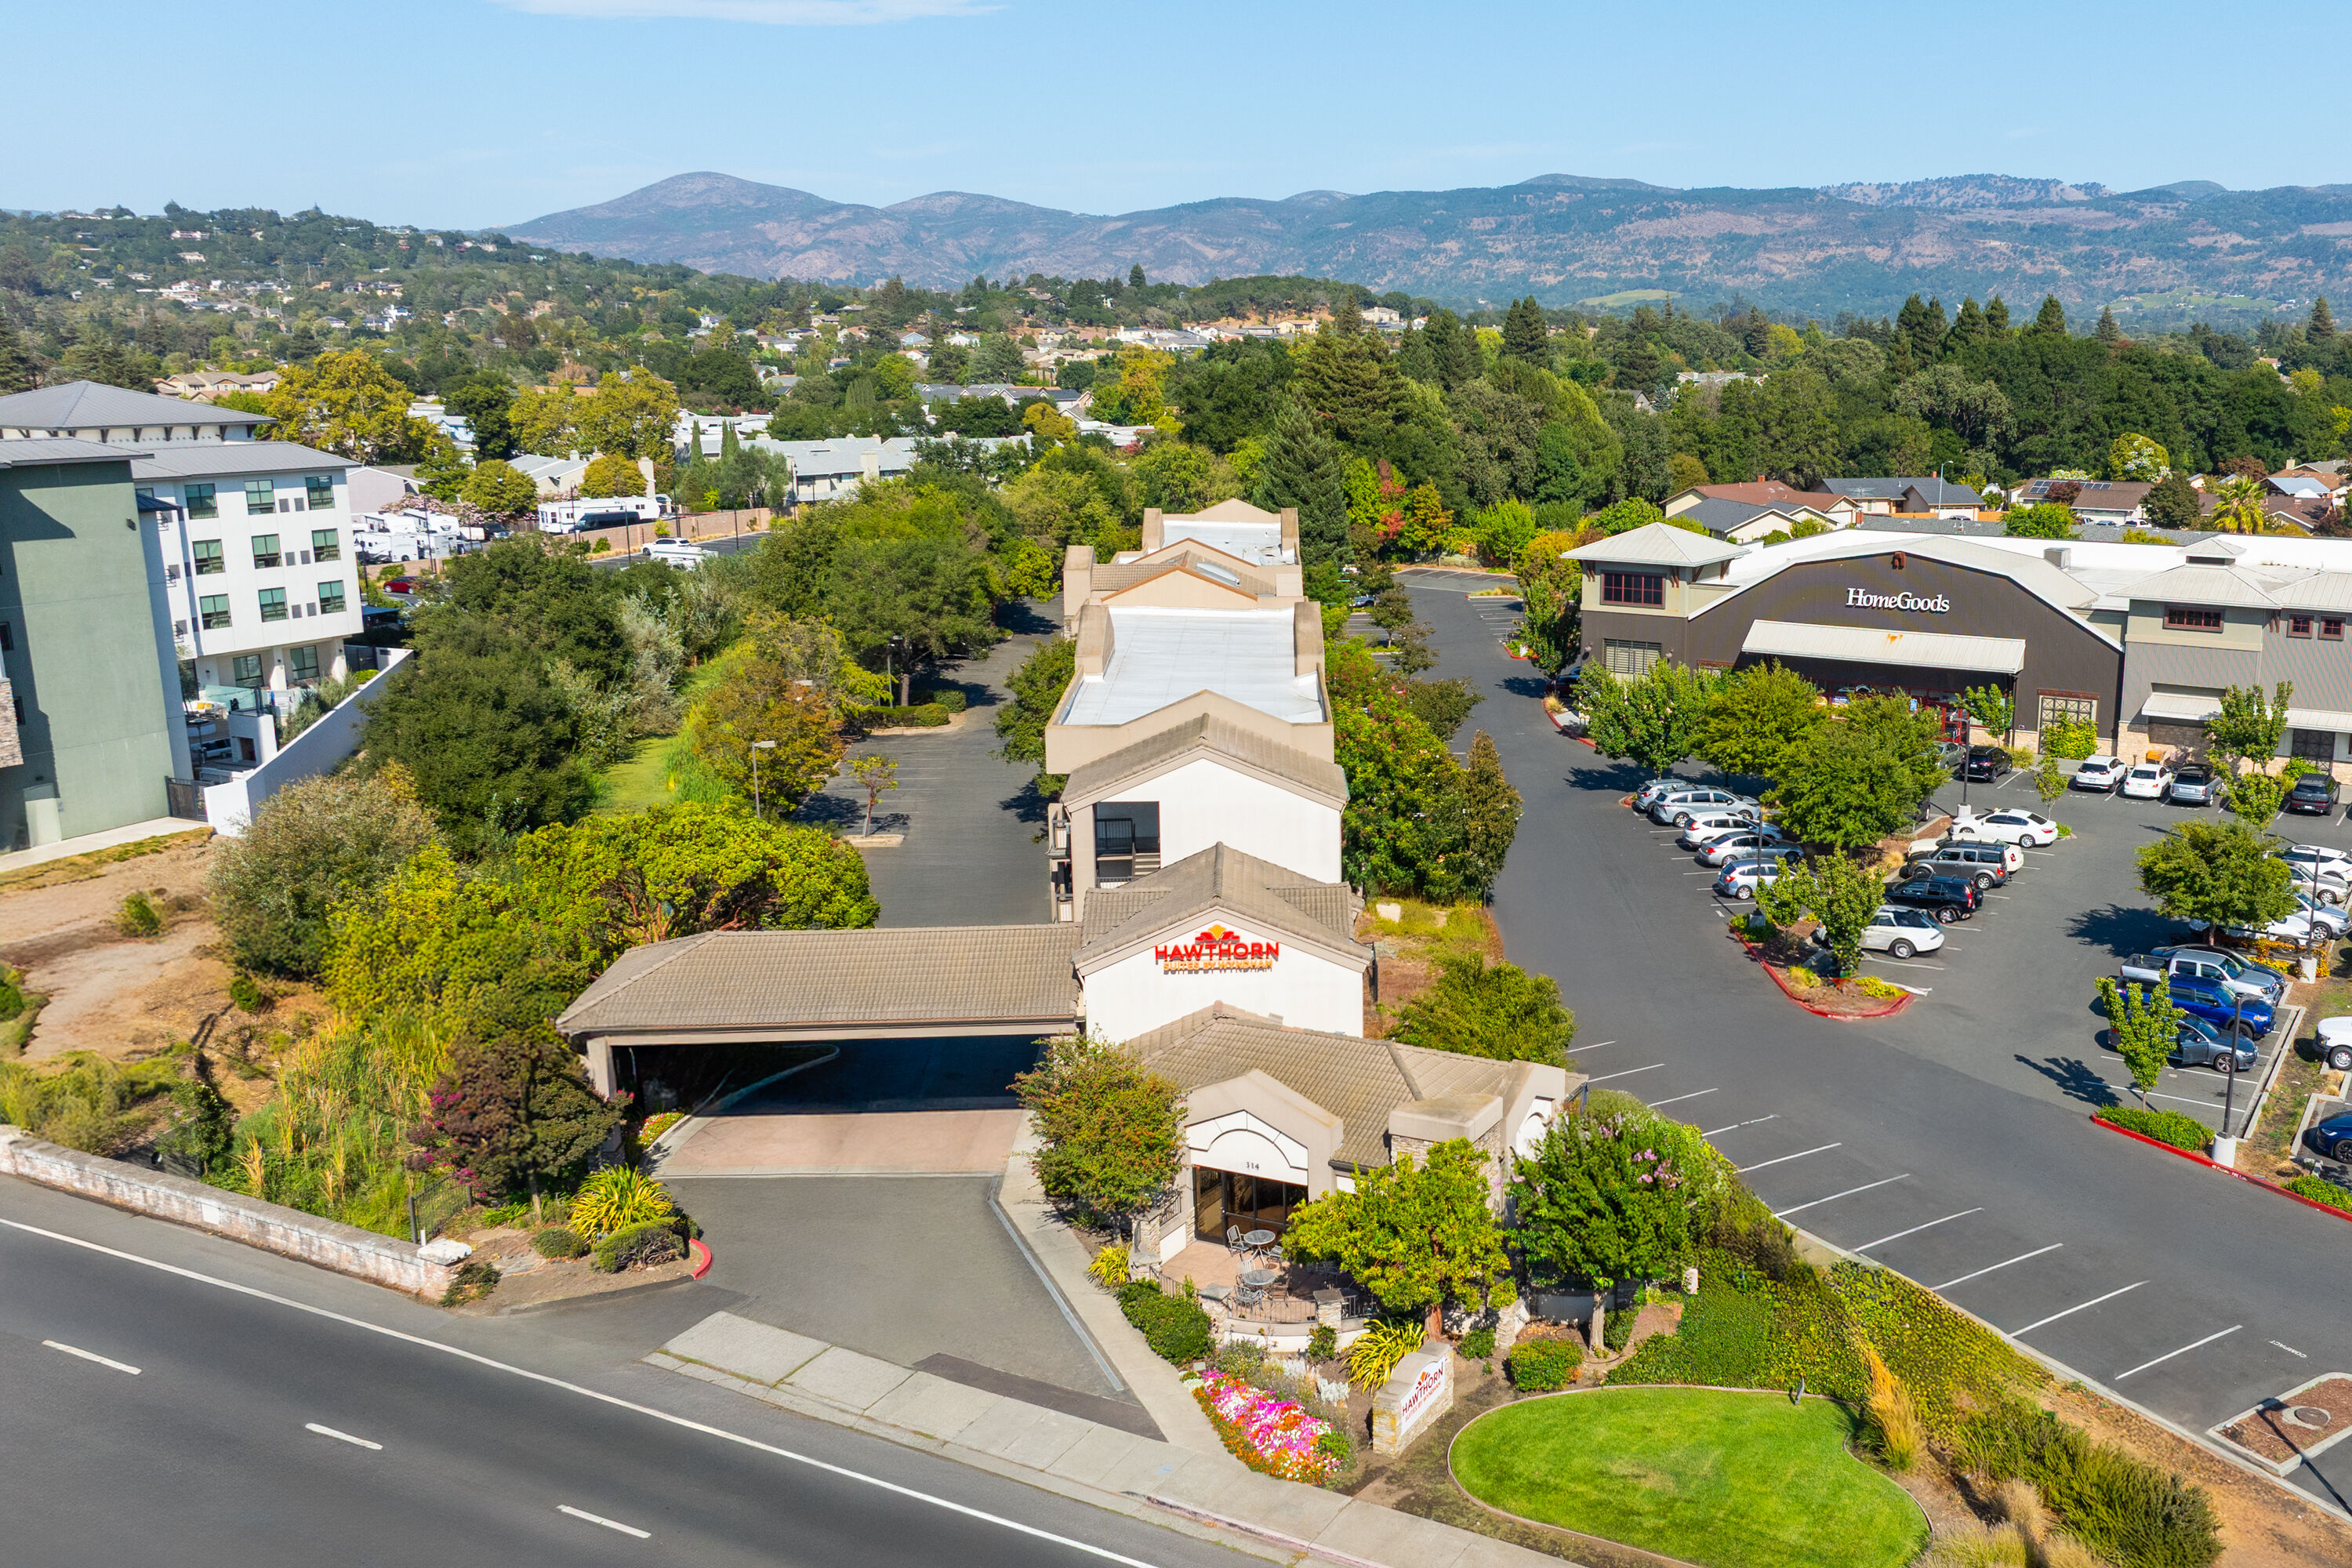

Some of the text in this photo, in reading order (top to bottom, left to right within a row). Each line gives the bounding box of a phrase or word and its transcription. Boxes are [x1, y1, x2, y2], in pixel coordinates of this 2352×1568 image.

[1846, 588, 1951, 612] HomeGoods
[1155, 942, 1279, 960] HAWTHORN
[1163, 959, 1273, 971] SUITES BY WYNDHAM
[1246, 1161, 1260, 1171] 314
[2268, 1340, 2307, 1358] COMPACT
[1402, 1361, 1443, 1417] HAWTHORN
